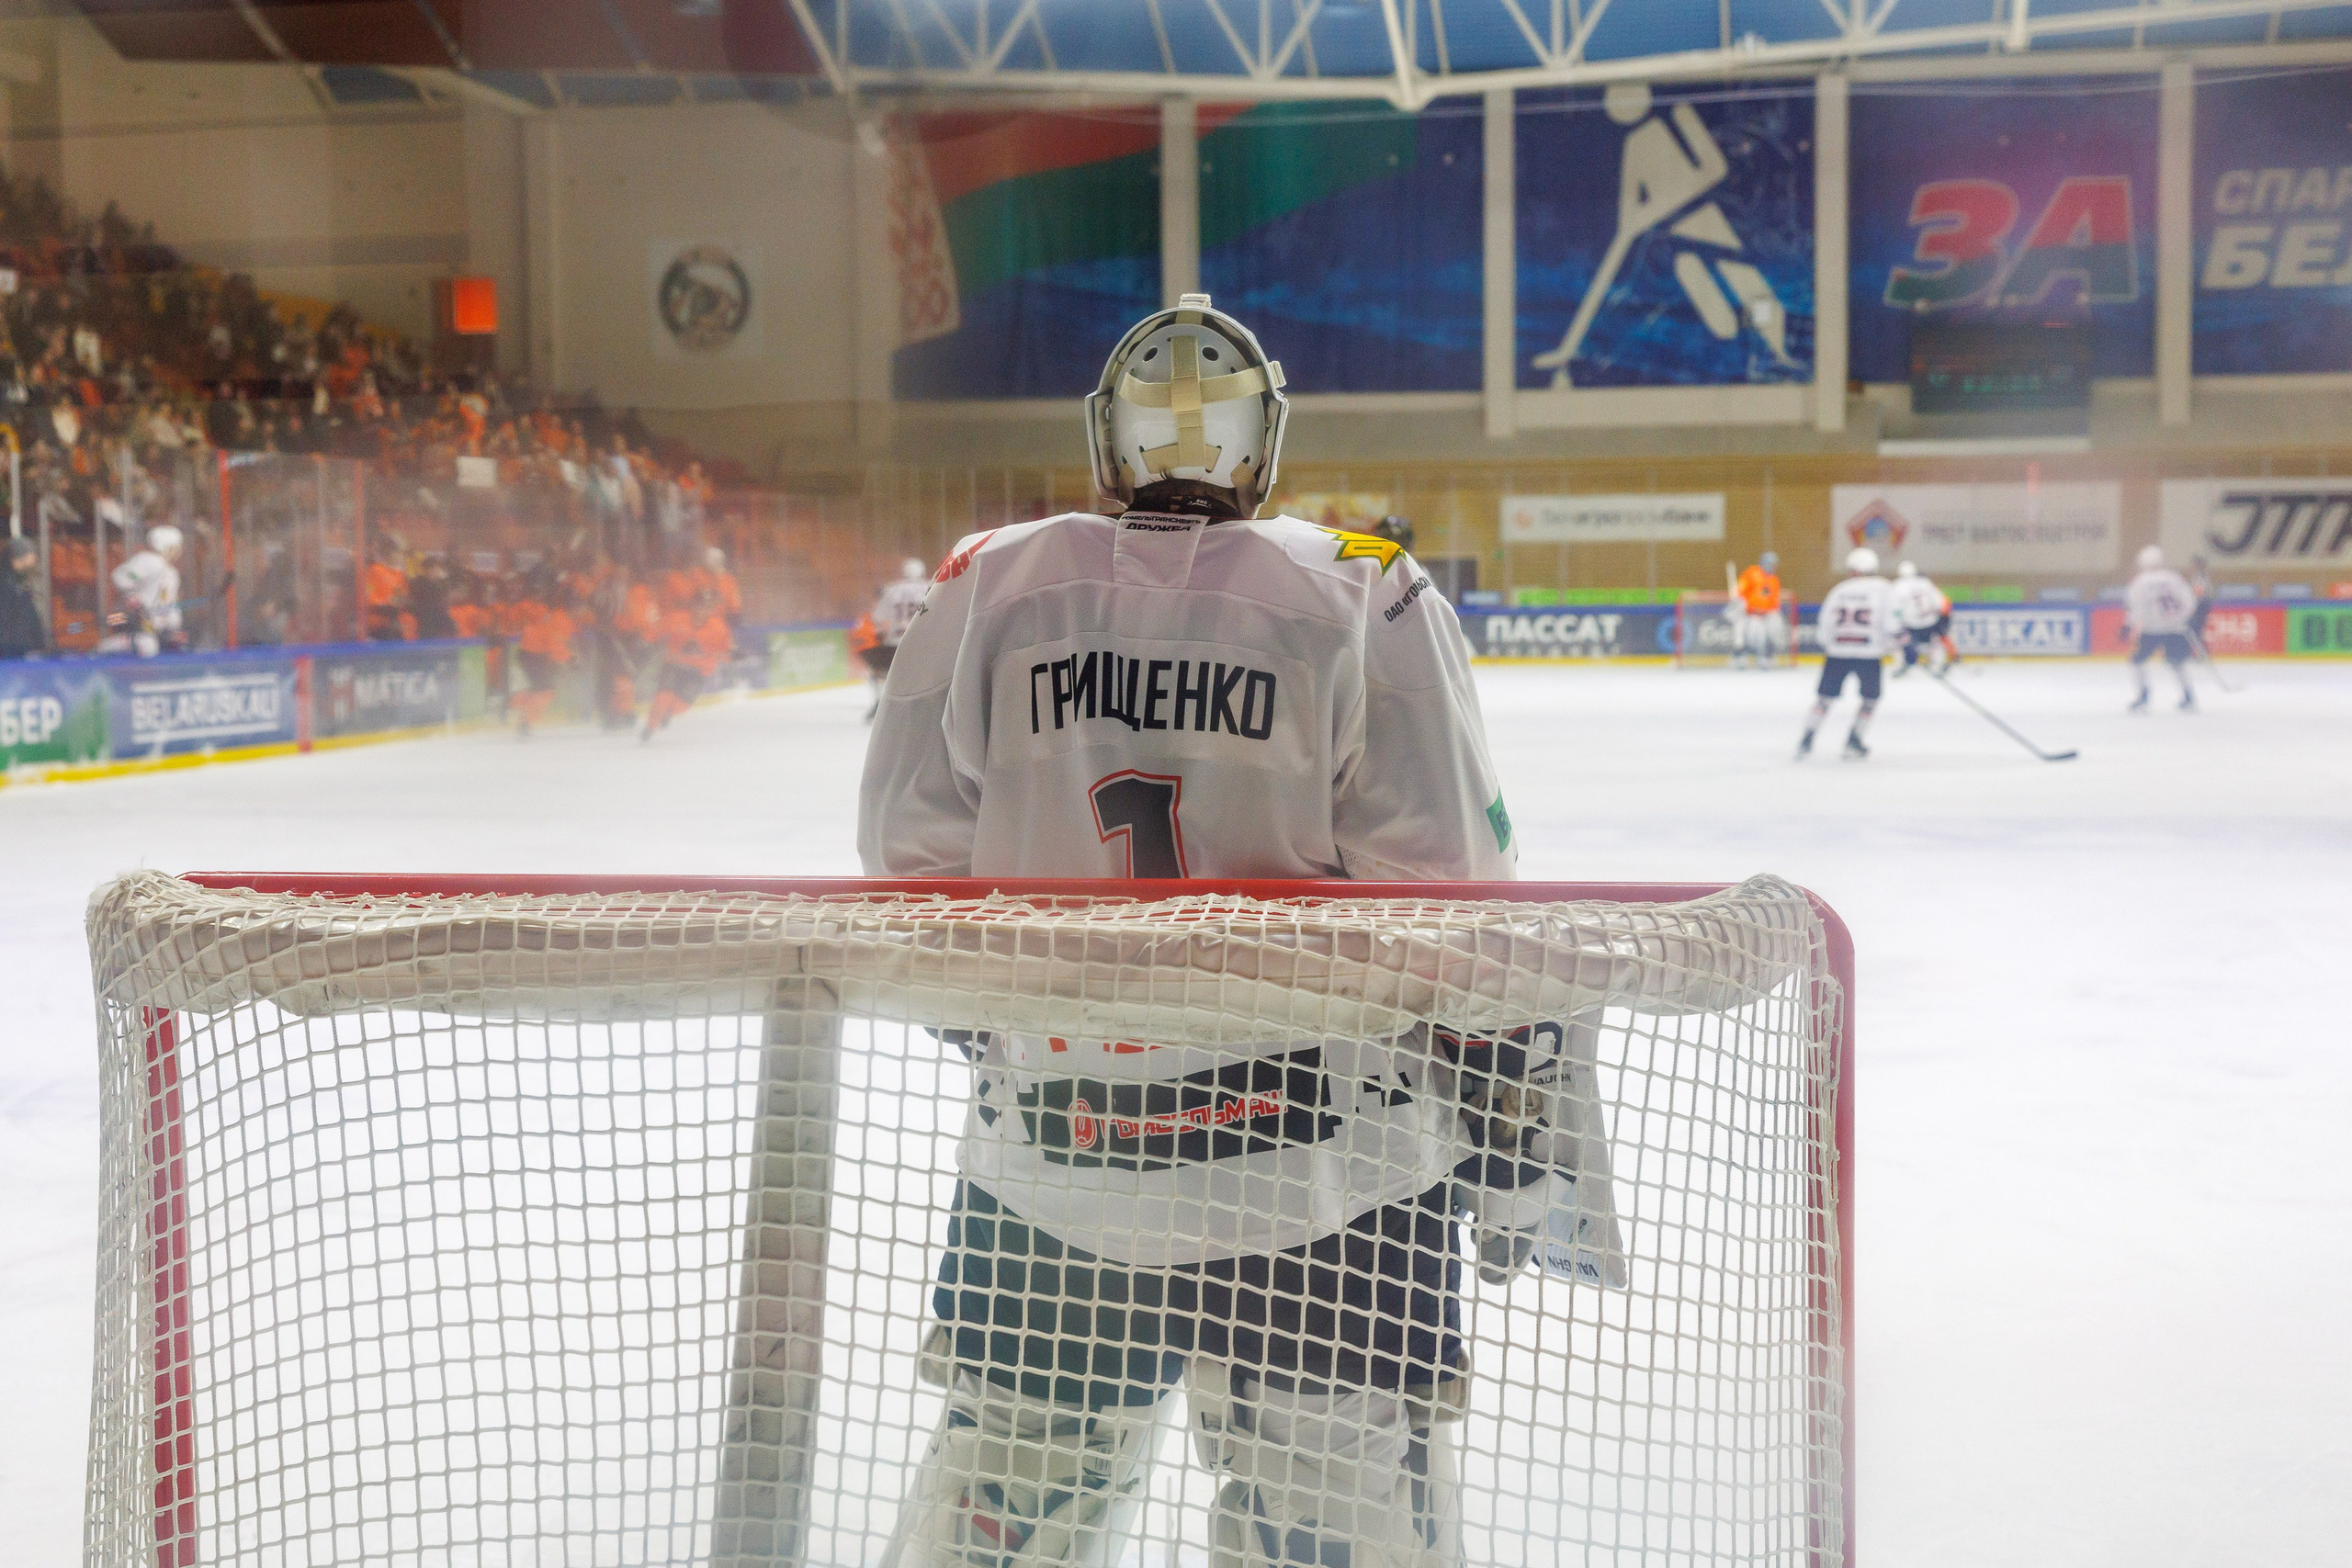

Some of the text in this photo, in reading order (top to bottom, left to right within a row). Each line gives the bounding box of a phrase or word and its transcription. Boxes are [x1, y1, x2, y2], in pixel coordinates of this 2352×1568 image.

[1885, 175, 2139, 310] ЗА
[1125, 522, 1192, 532] ДРУЖБА
[1384, 601, 1405, 623] ОАО
[1487, 614, 1622, 643] ПАССАТ
[1031, 650, 1277, 740] ГРИЩЕНКО
[1088, 768, 1190, 879] 1
